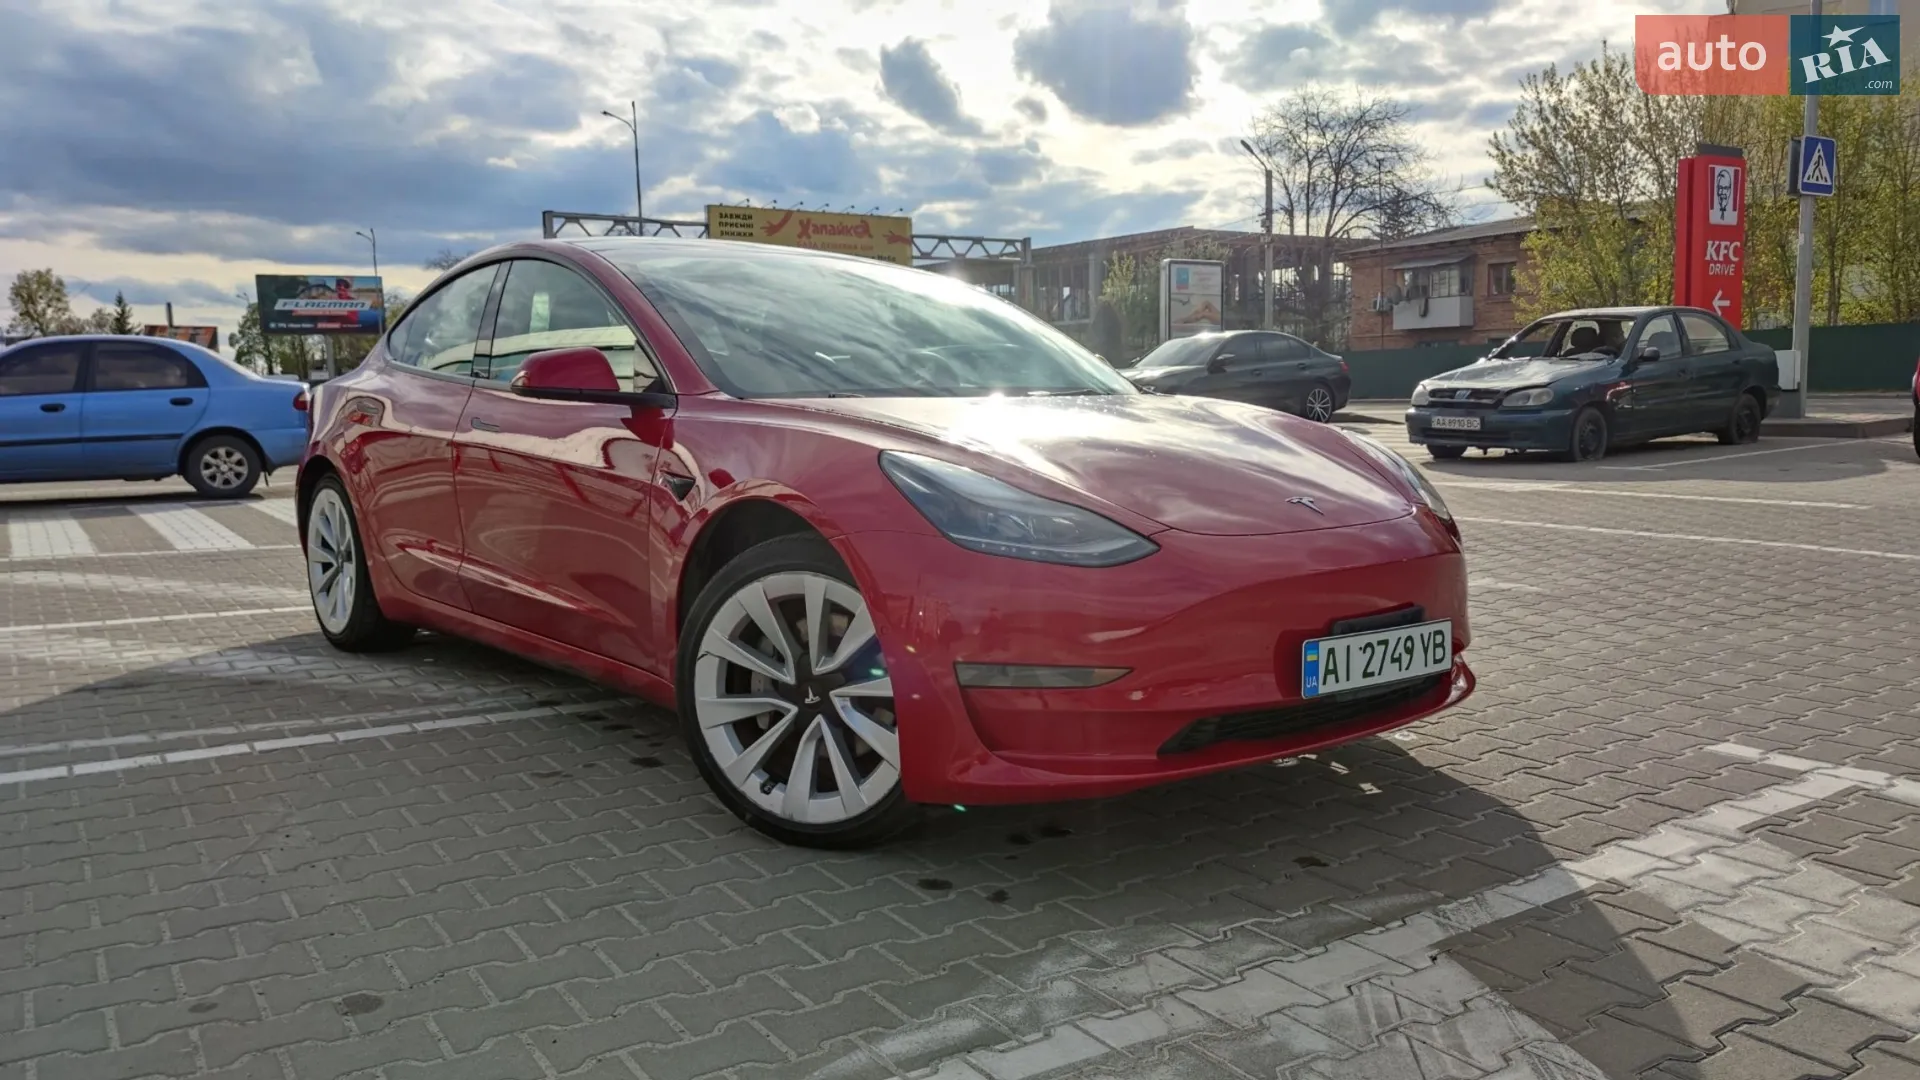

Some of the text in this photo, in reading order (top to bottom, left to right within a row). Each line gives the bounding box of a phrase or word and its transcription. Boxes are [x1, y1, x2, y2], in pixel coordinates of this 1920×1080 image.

[719, 212, 753, 221] ЗАВЖДИ
[1705, 240, 1741, 262] KFC
[1708, 263, 1736, 276] DRIVE
[281, 300, 367, 309] FLAGMAN
[1436, 417, 1447, 428] AA
[1322, 629, 1446, 686] AI 2749 YB
[1305, 676, 1318, 689] UA
